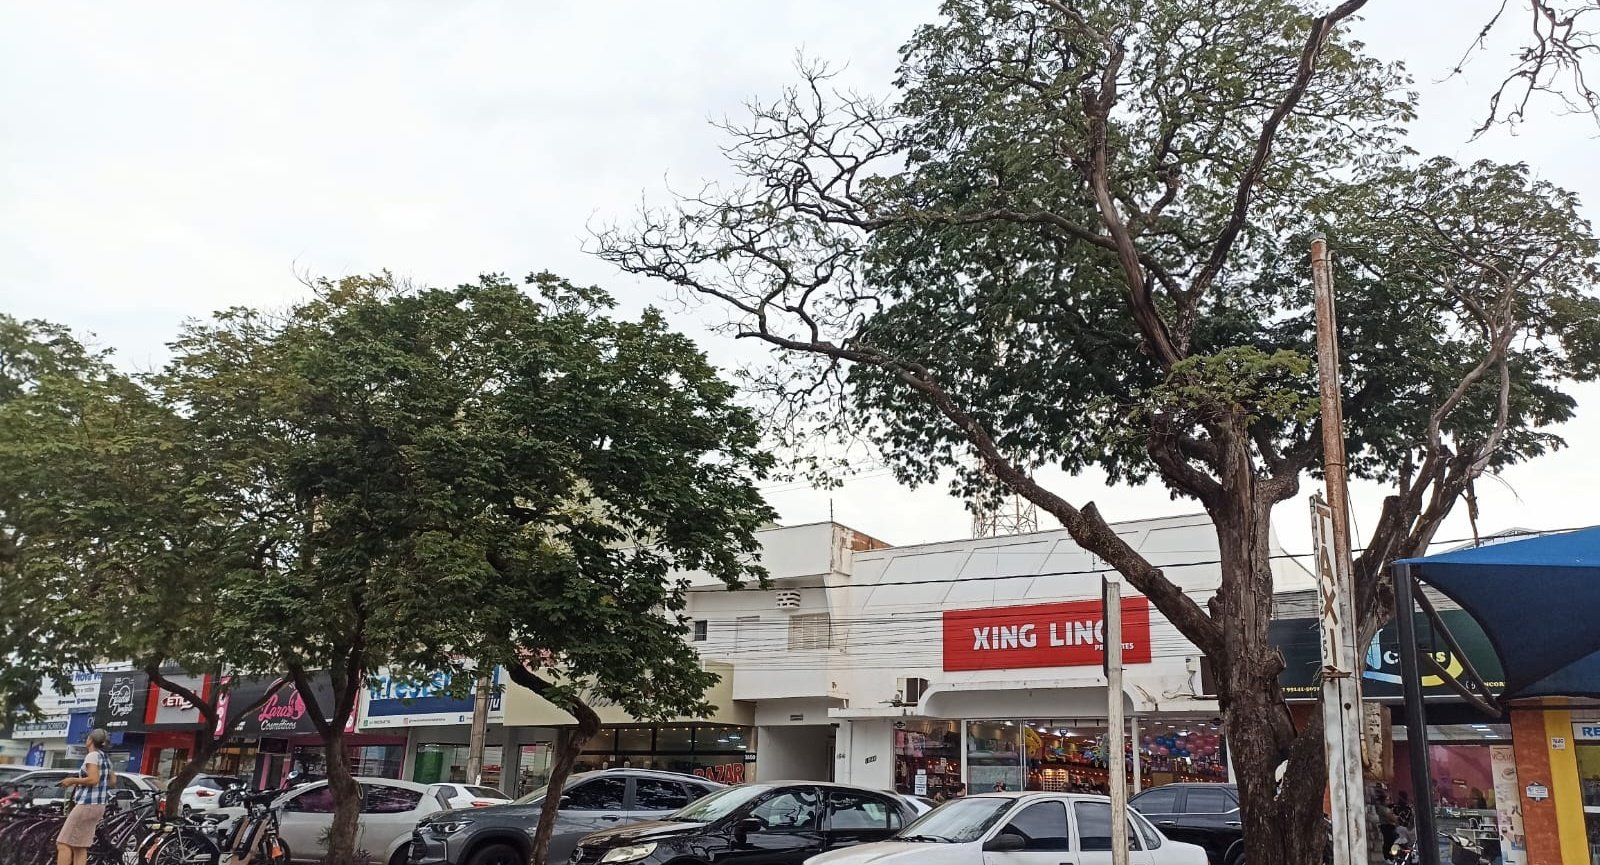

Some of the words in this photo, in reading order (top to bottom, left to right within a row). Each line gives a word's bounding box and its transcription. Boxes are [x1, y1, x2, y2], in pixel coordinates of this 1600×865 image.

[1316, 505, 1338, 668] TAXI
[973, 623, 1037, 651] XING
[1094, 643, 1134, 651] PRTES
